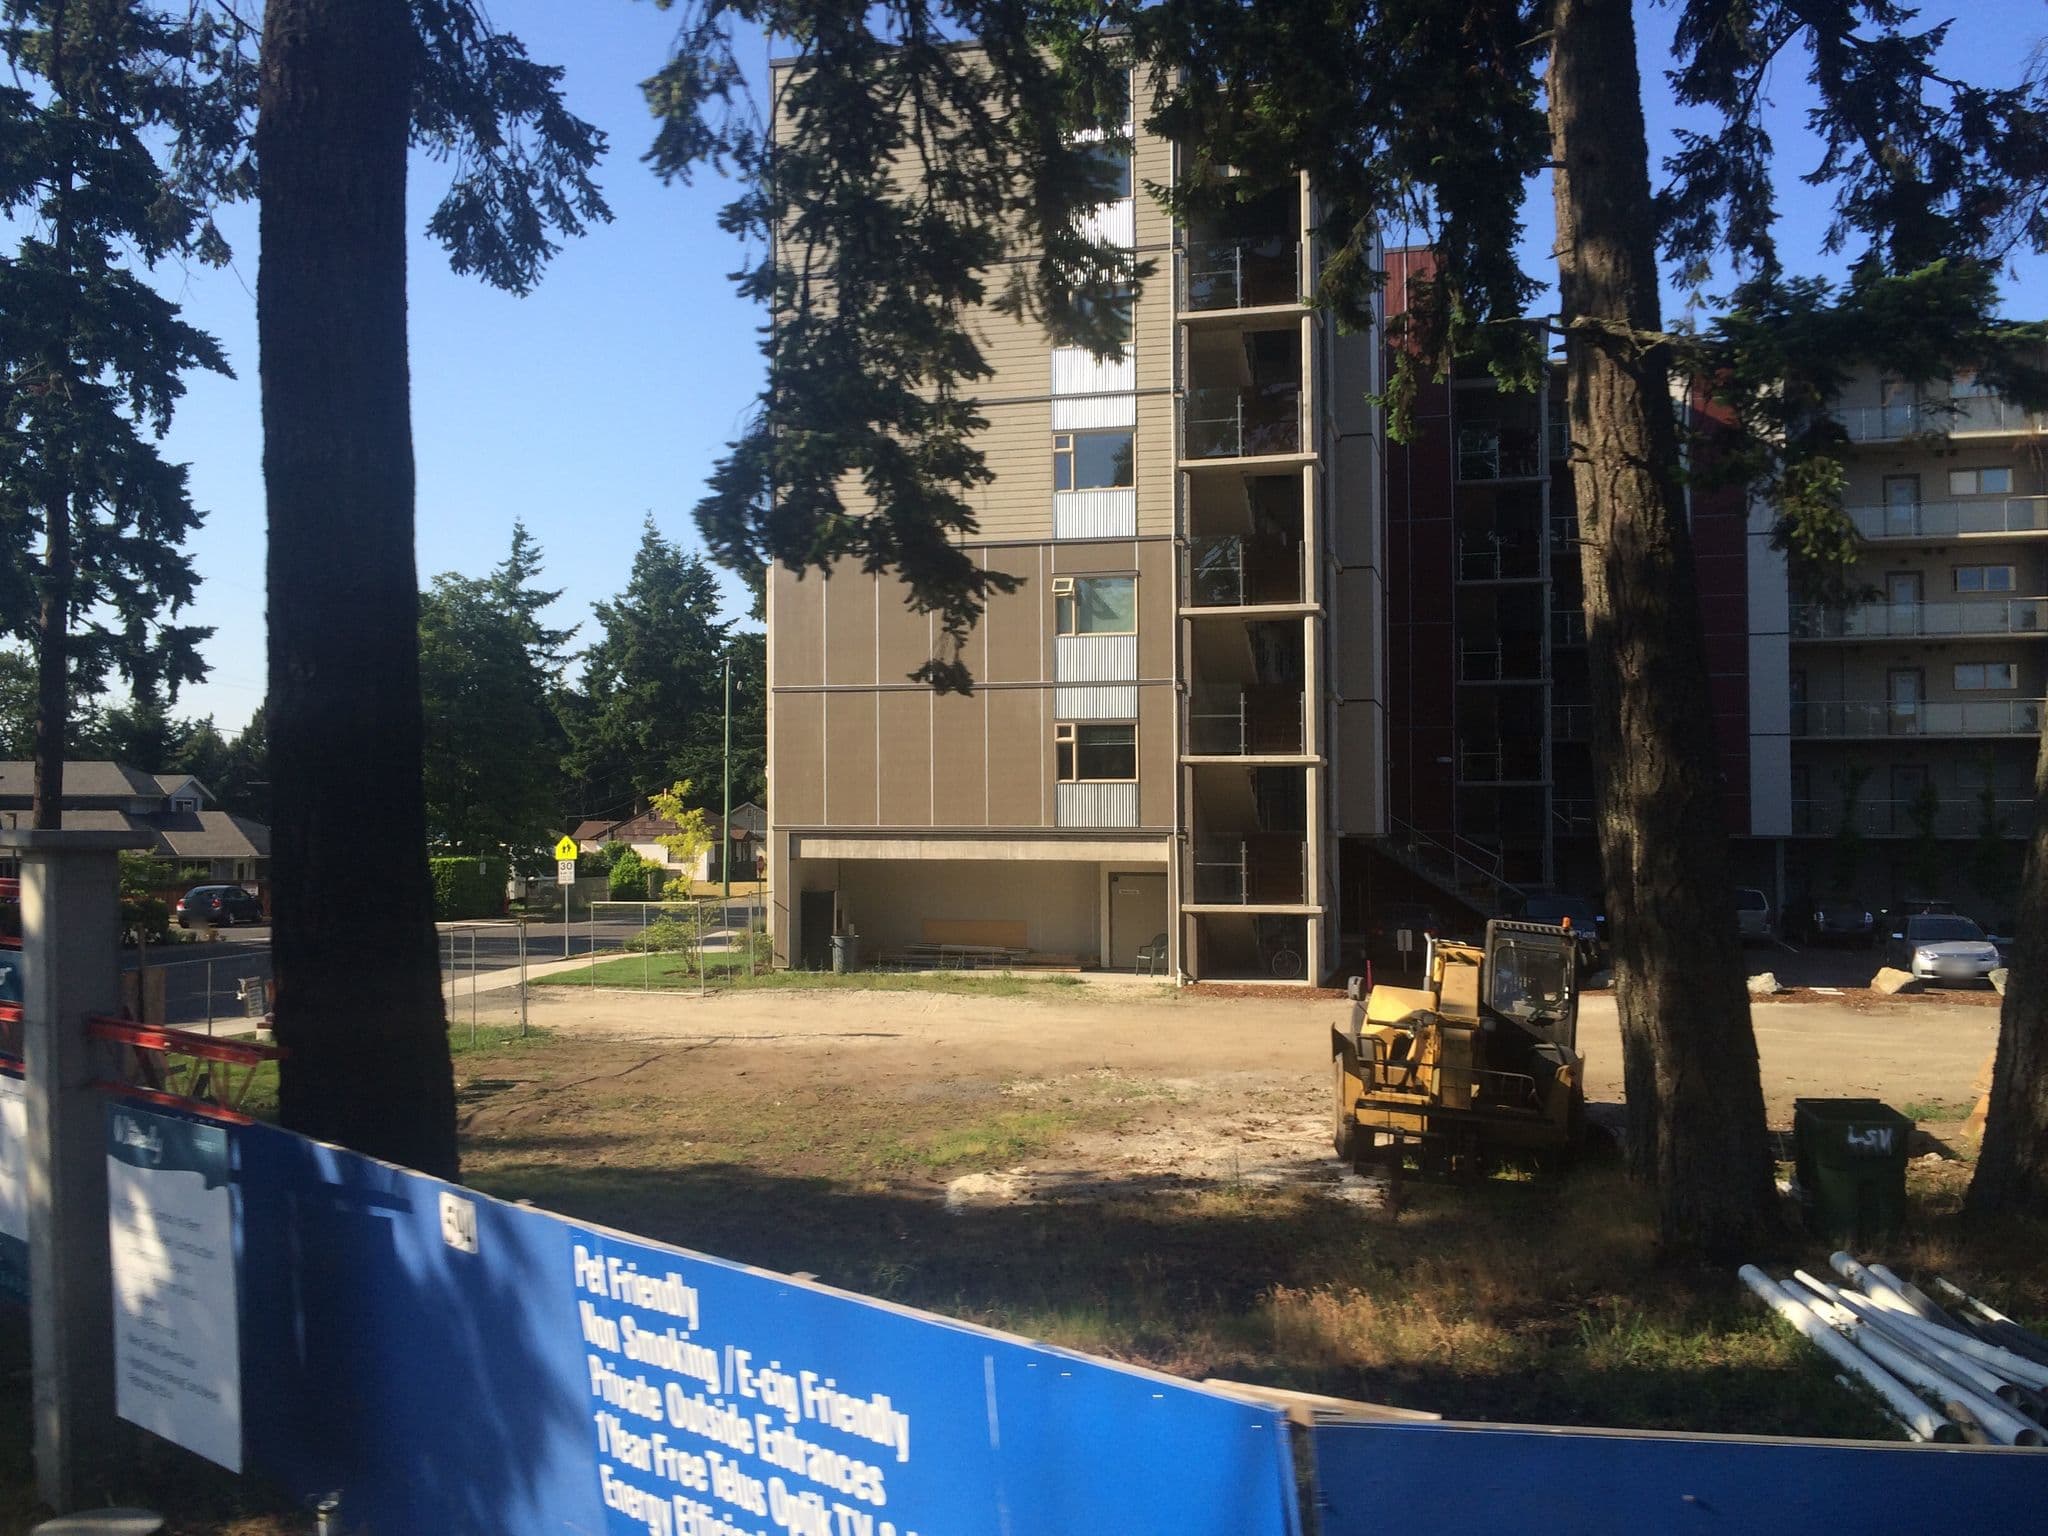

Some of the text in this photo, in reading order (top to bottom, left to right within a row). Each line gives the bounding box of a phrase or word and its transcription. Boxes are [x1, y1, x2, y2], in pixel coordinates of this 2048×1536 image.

[560, 862, 573, 871] 30
[607, 1257, 699, 1331] Friendly
[578, 1300, 621, 1353] Non
[620, 1315, 721, 1394] Smoking
[800, 1370, 910, 1463] Friendly
[587, 1353, 887, 1506] Private Outside Entrances
[599, 1463, 673, 1536] Energy
[651, 1433, 709, 1492] Free
[704, 1450, 768, 1516] Telus
